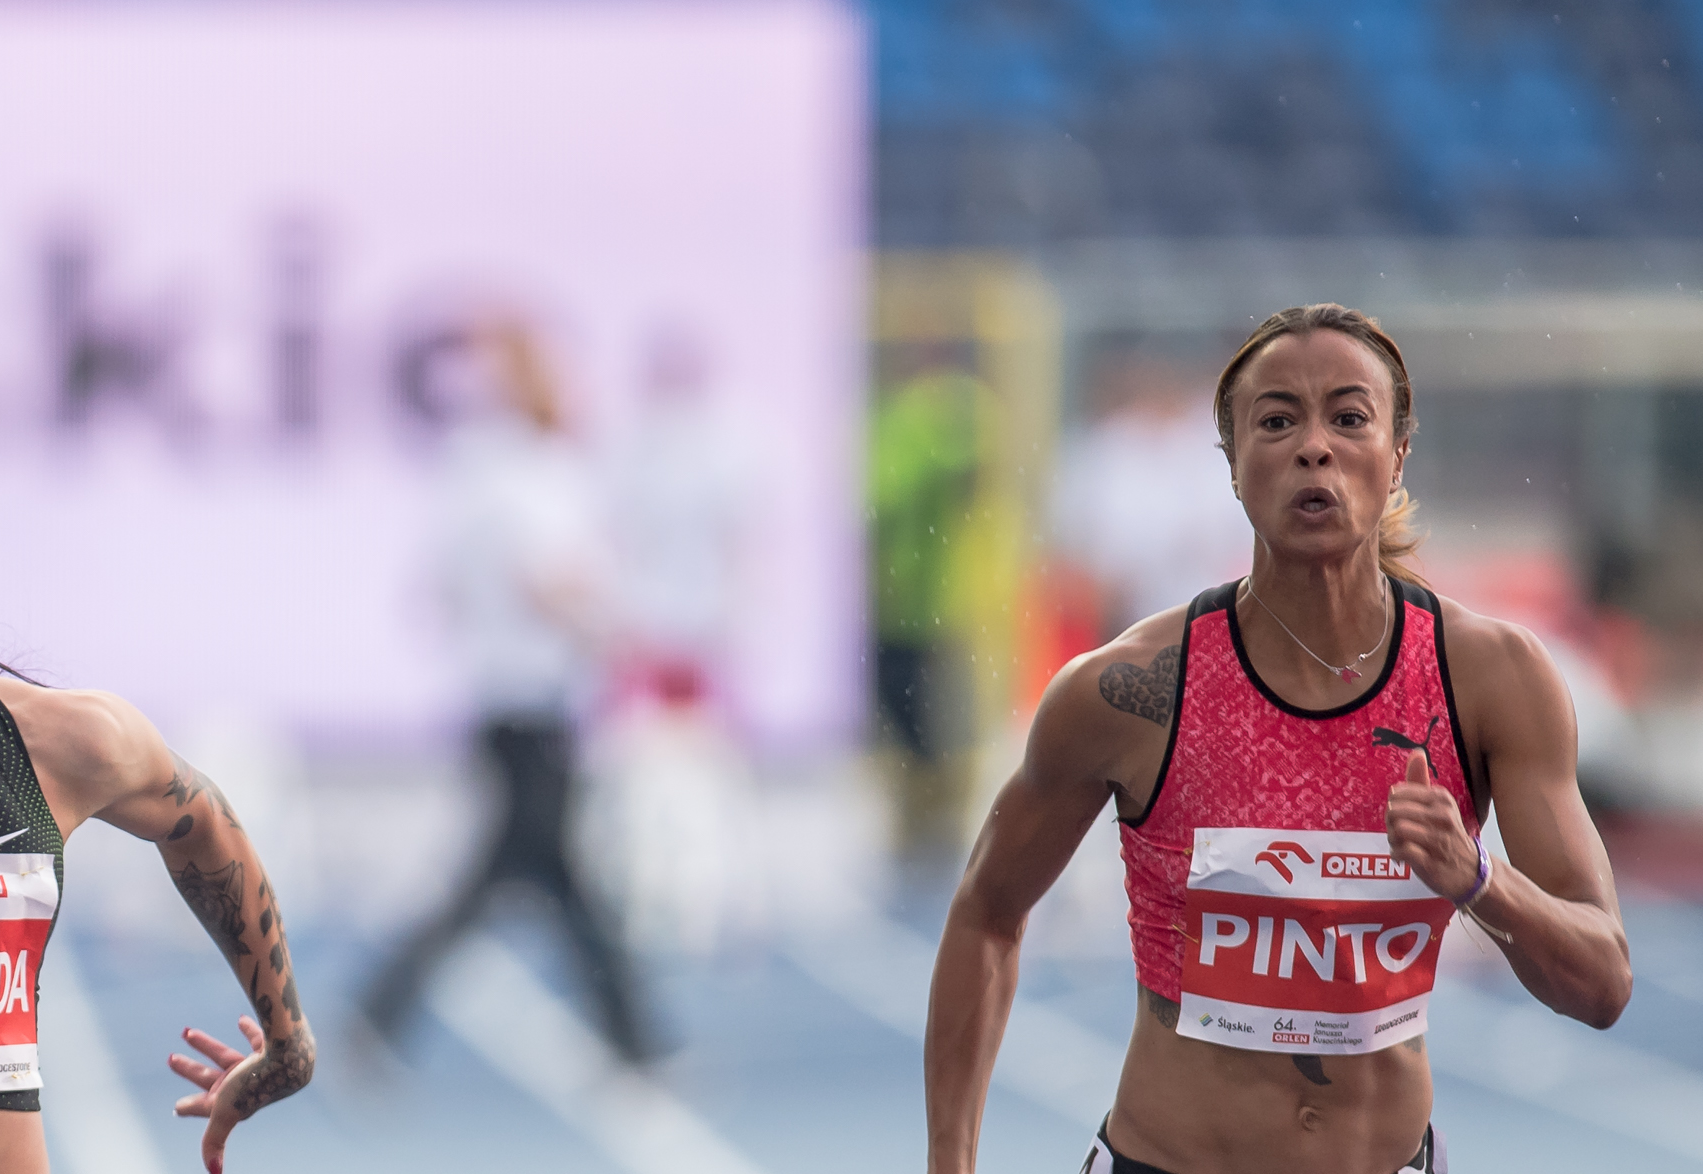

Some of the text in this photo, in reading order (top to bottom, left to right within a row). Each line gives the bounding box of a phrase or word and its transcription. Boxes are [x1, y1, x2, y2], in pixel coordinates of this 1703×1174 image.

[1326, 855, 1405, 877] ORLEN
[1199, 912, 1432, 984] PINTO
[1274, 1034, 1308, 1043] ORLEN
